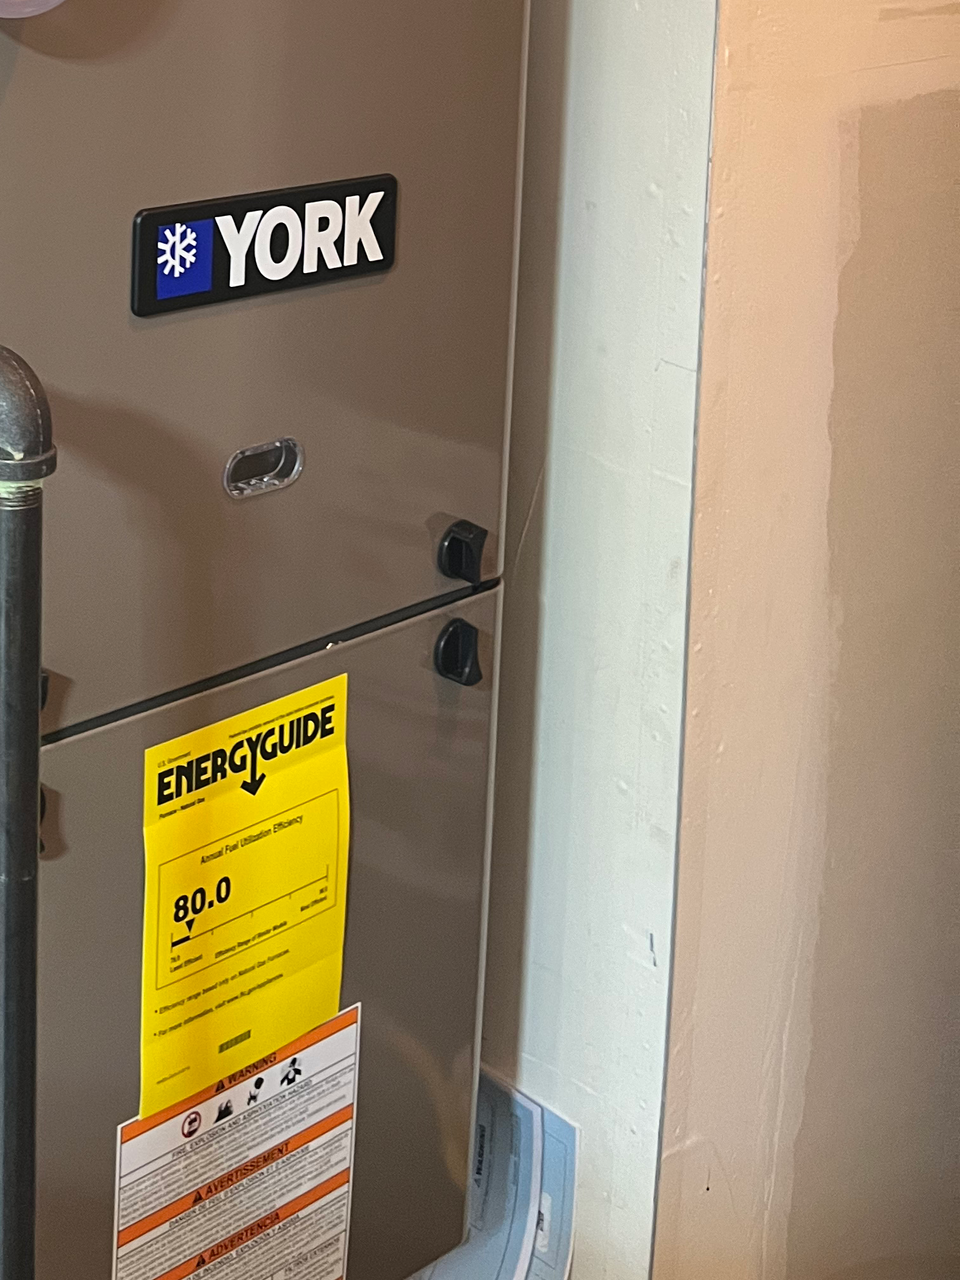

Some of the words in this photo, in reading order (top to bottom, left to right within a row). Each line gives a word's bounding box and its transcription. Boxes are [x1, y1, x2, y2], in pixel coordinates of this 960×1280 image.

[215, 191, 385, 287] YORK
[157, 704, 335, 806] ENERGYGUIDE
[200, 846, 224, 865] Annual
[225, 840, 239, 854] Fuel
[240, 828, 272, 847] Utilization
[272, 815, 303, 834] Efficiency
[173, 876, 231, 923] 80.0
[228, 1052, 277, 1085] WARNING
[205, 1142, 291, 1197] AVERTISSEMENT
[208, 1211, 280, 1260] ADVERTENCIA
